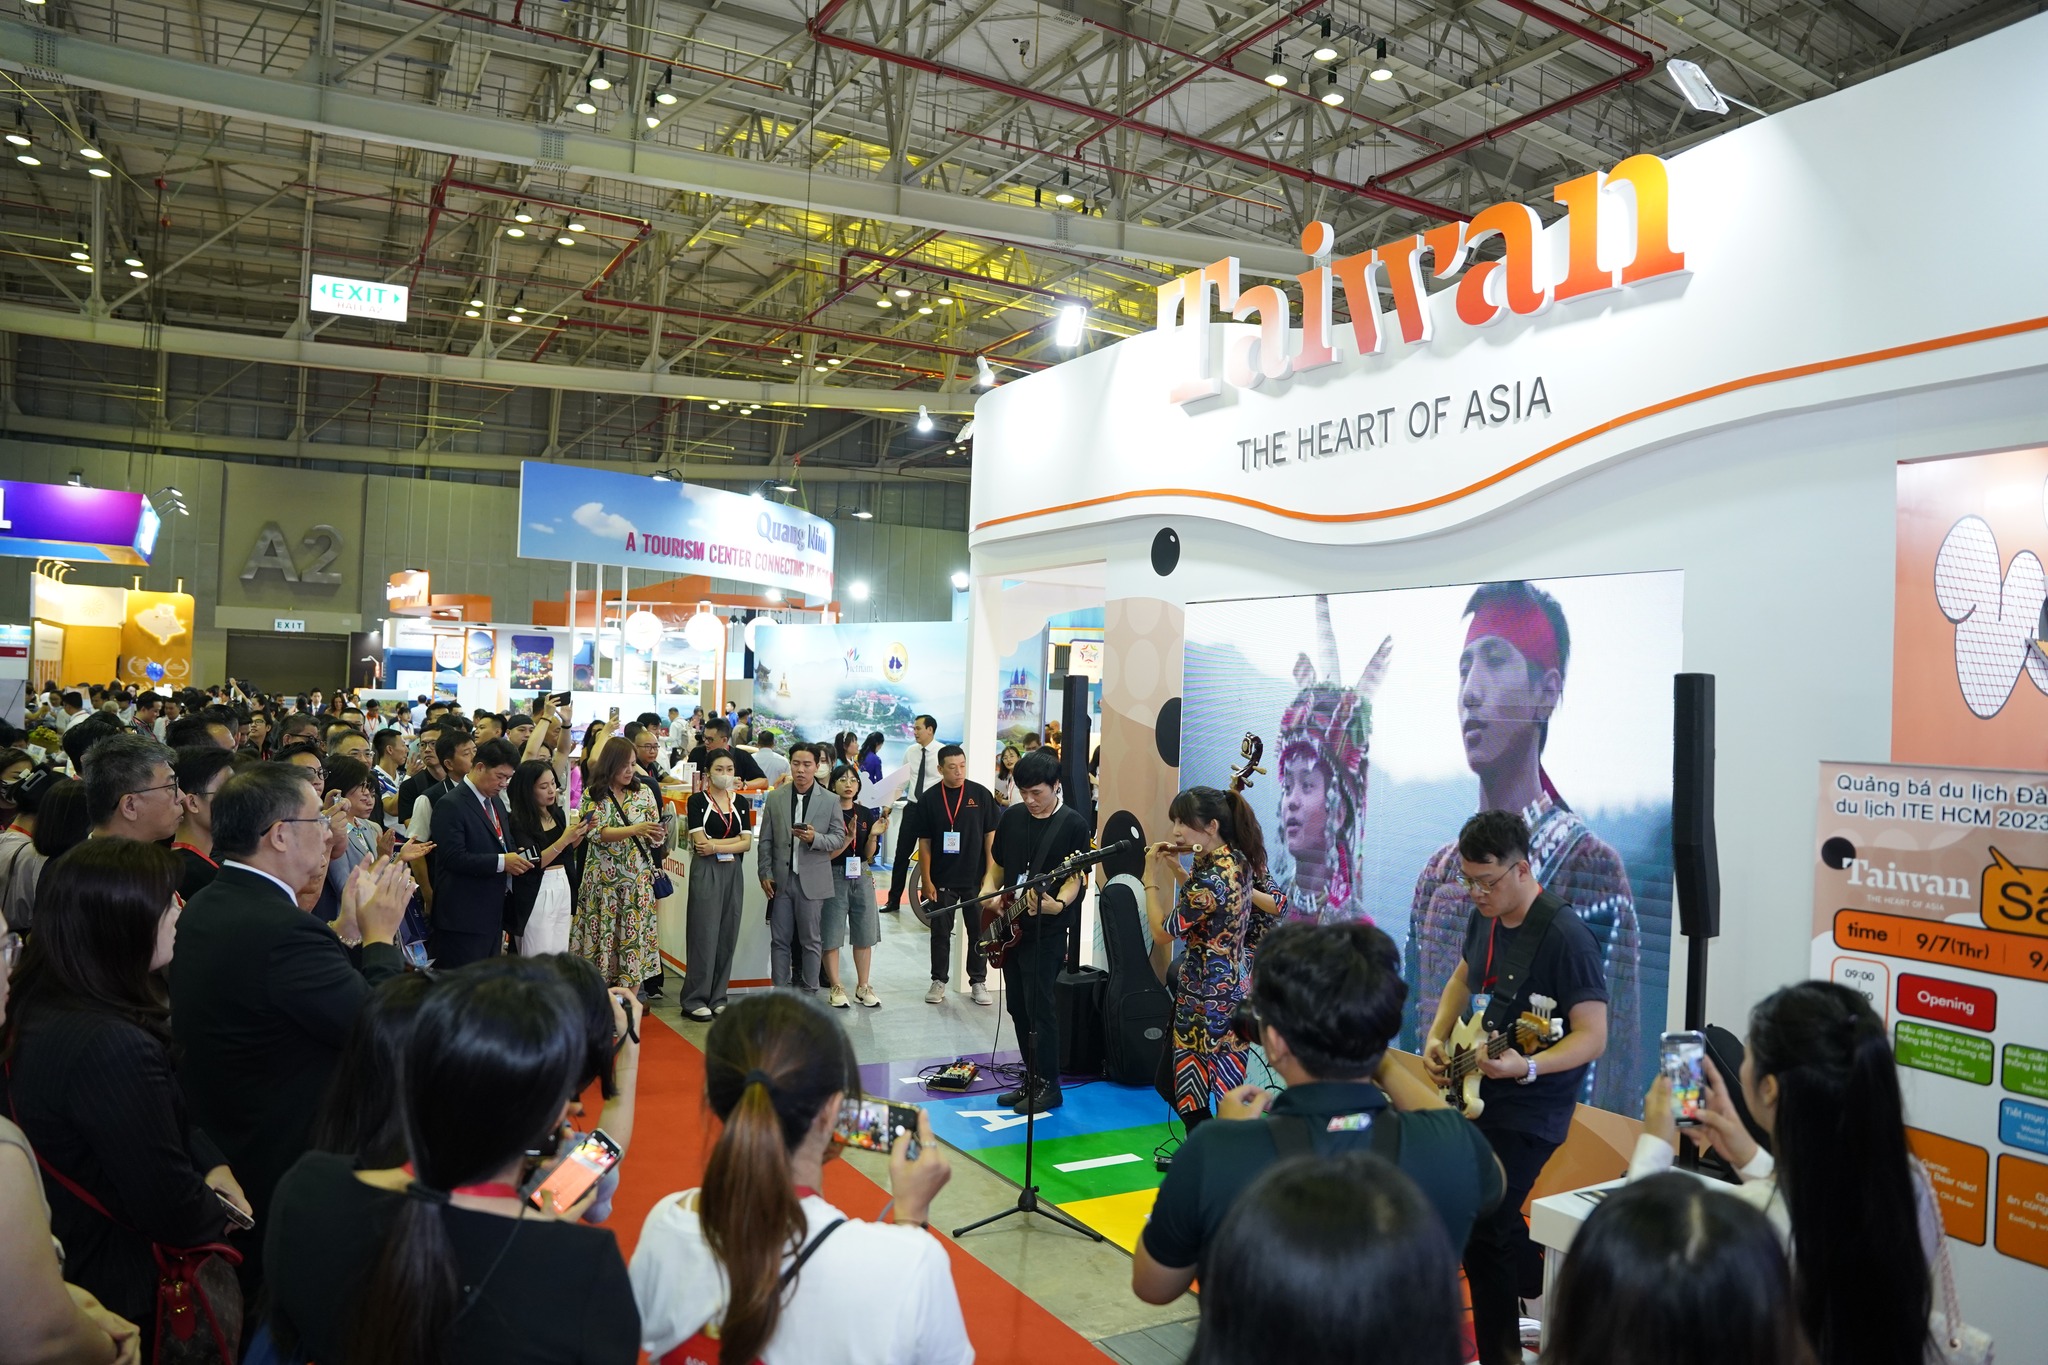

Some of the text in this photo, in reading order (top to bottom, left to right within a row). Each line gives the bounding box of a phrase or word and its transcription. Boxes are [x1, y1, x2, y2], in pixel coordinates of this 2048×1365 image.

[332, 283, 388, 303] EXIT
[1157, 153, 1688, 407] Taiwan
[1237, 376, 1552, 471] THE HEART OF ASIA
[757, 512, 806, 552] Quang
[240, 521, 344, 585] A2
[625, 532, 636, 551] A
[642, 533, 705, 561] TOURISM
[709, 543, 752, 568] CENTER
[755, 552, 805, 577] CONNECTING
[277, 621, 303, 630] EXIT
[1837, 774, 1900, 797] Quảng
[1908, 779, 1931, 796] bá
[1939, 782, 1963, 799] du
[1972, 783, 2007, 803] lịch
[1836, 798, 2048, 831] du lịch ITE HCM 2023
[663, 857, 685, 878] aiwan
[1842, 857, 1972, 899] Taiwan
[1866, 894, 1945, 911] THE HEART OF ASIA
[1847, 922, 1888, 942] time
[1916, 932, 1989, 960] 9/7(Thr)
[1845, 968, 1875, 982] 09:00
[1917, 990, 1975, 1016] Opening
